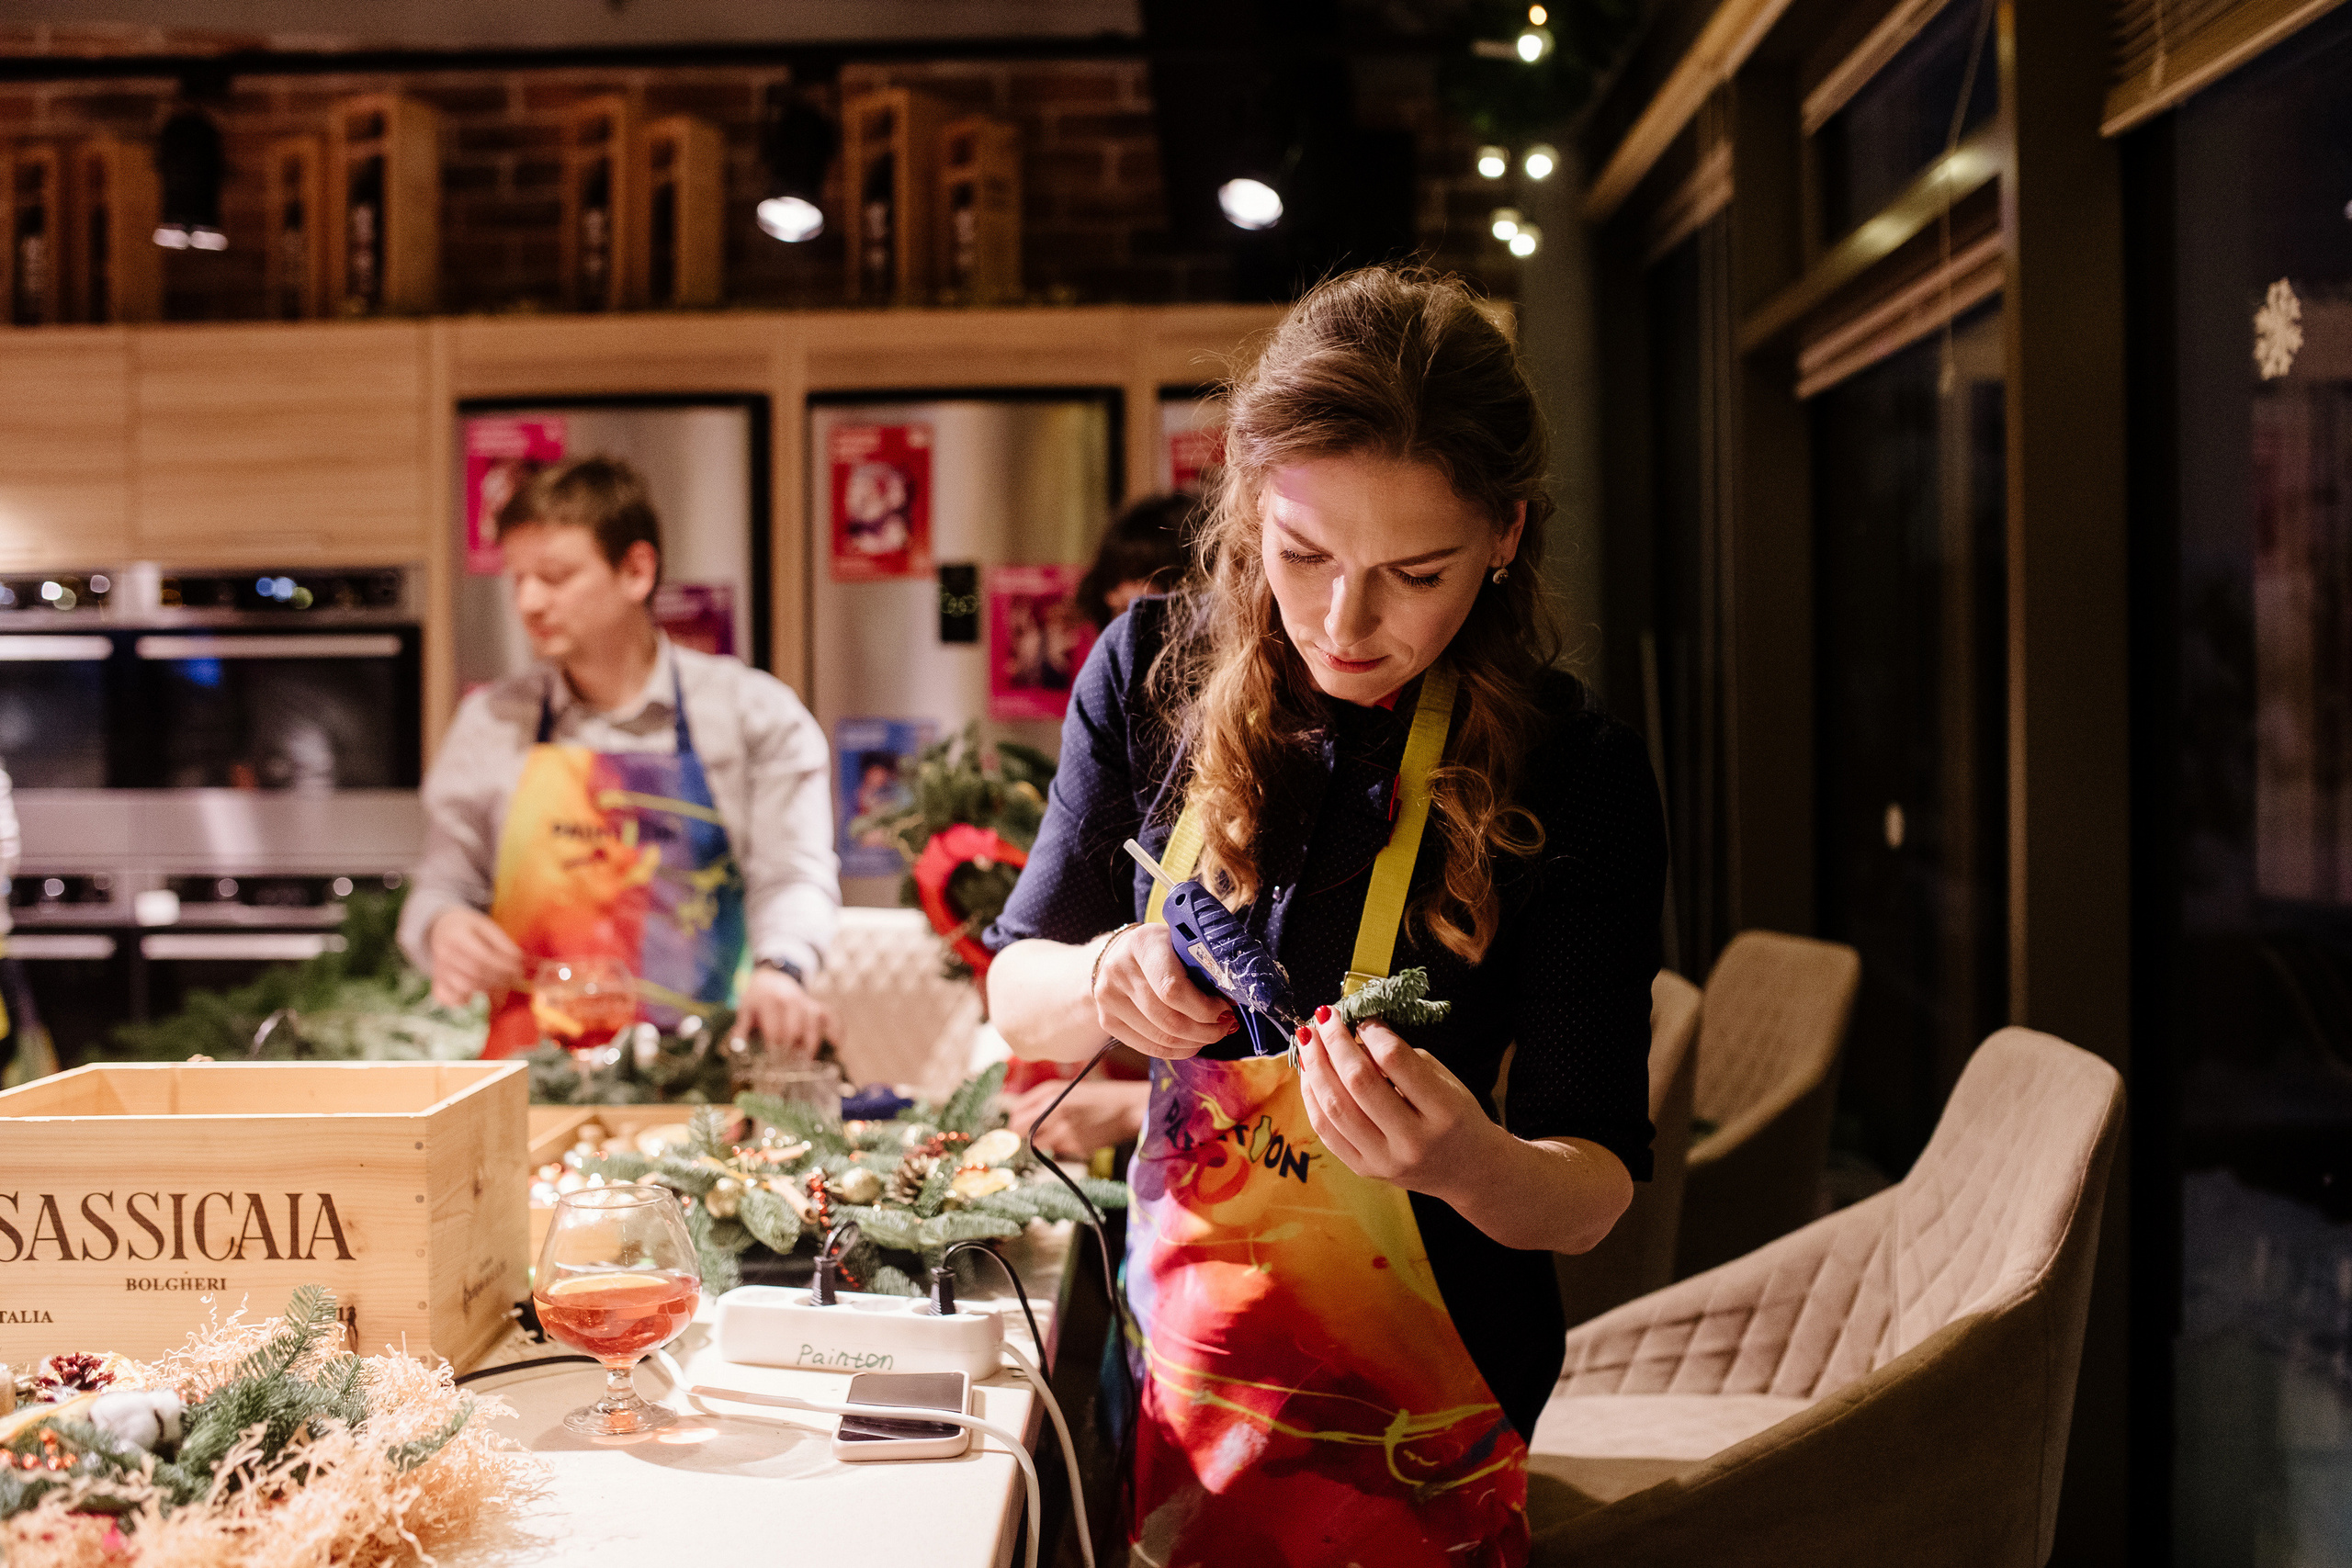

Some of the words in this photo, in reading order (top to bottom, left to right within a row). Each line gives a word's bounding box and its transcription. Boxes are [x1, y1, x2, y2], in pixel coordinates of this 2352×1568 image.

[0, 1191, 356, 1262] SASSICAIA
[126, 1277, 227, 1292] BOLGHERI
[797, 1344, 894, 1371] Painton
